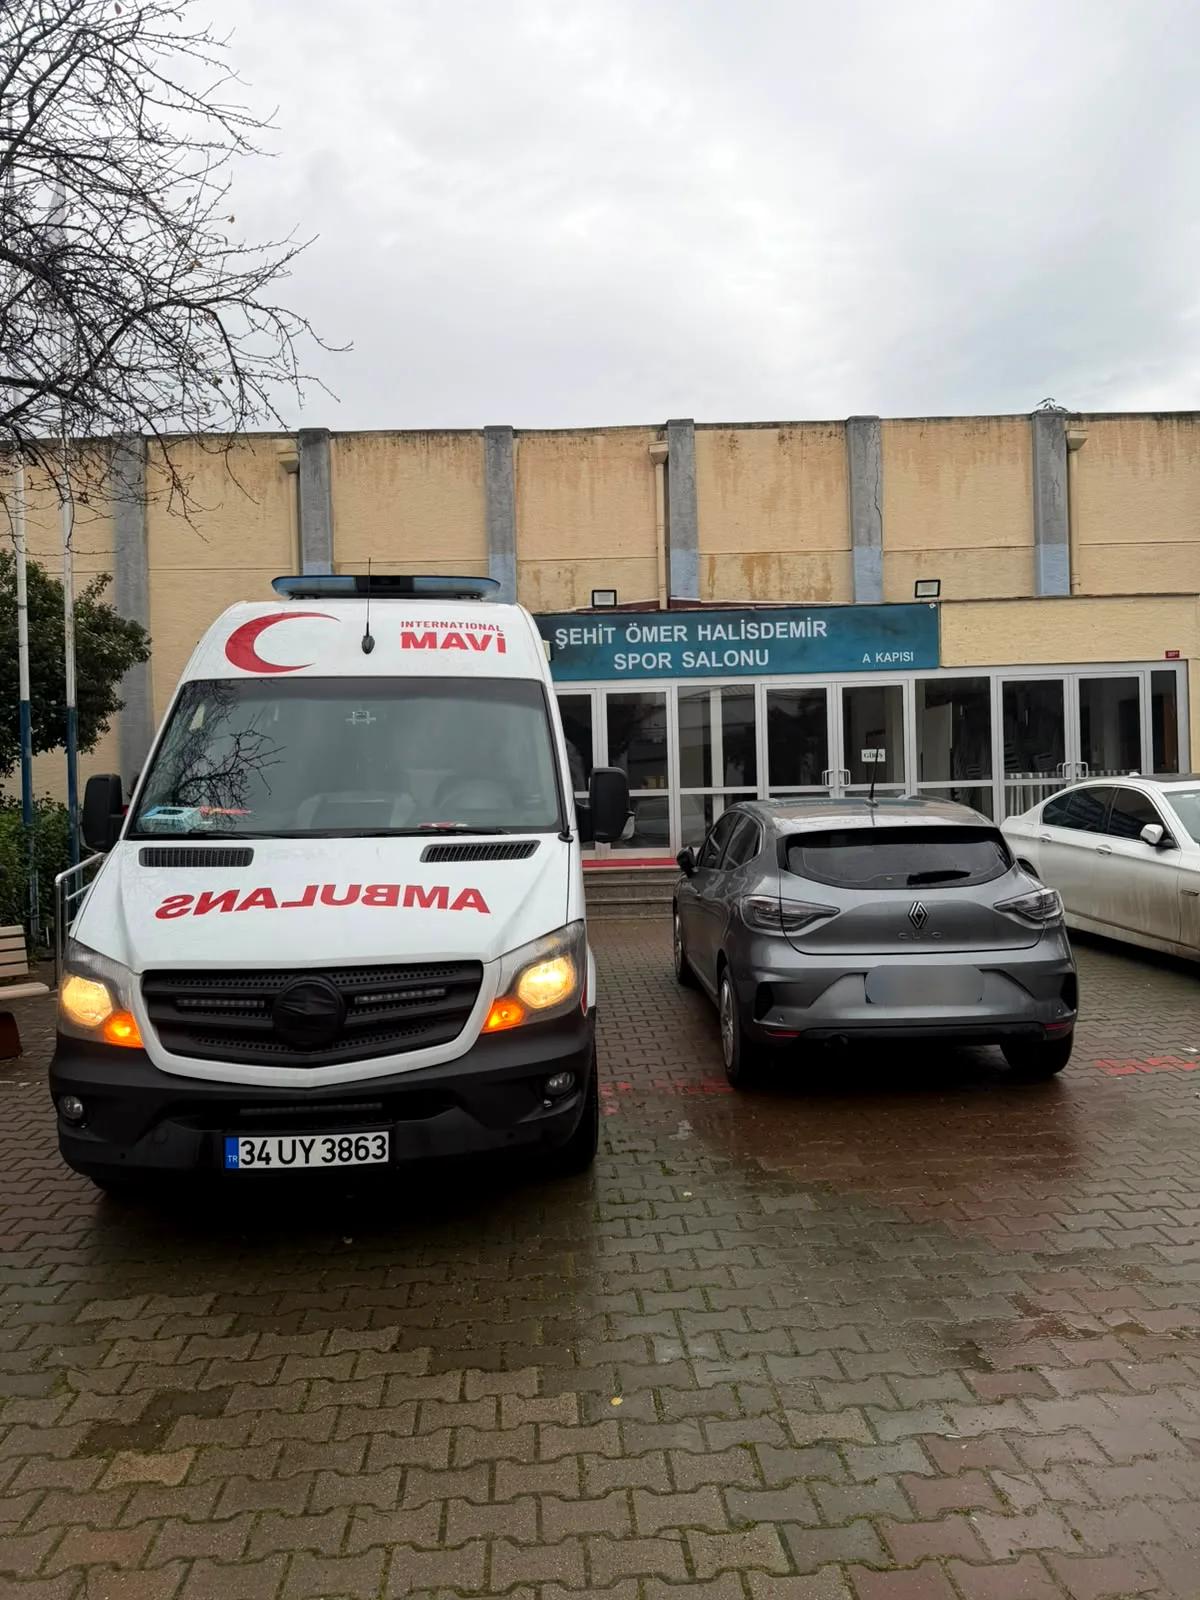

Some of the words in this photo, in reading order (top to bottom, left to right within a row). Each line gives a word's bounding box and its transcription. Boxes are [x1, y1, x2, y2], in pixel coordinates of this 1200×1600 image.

[401, 621, 503, 632] INTERNATIONAL
[555, 624, 616, 649] ŞEHİT
[625, 622, 687, 643] ÖMER
[697, 619, 828, 642] HALİSDEMİR
[614, 652, 672, 670] SPOR
[681, 649, 769, 668] SALONU
[862, 653, 871, 663] A
[875, 651, 914, 663] KAPISI
[227, 1155, 238, 1163] TR
